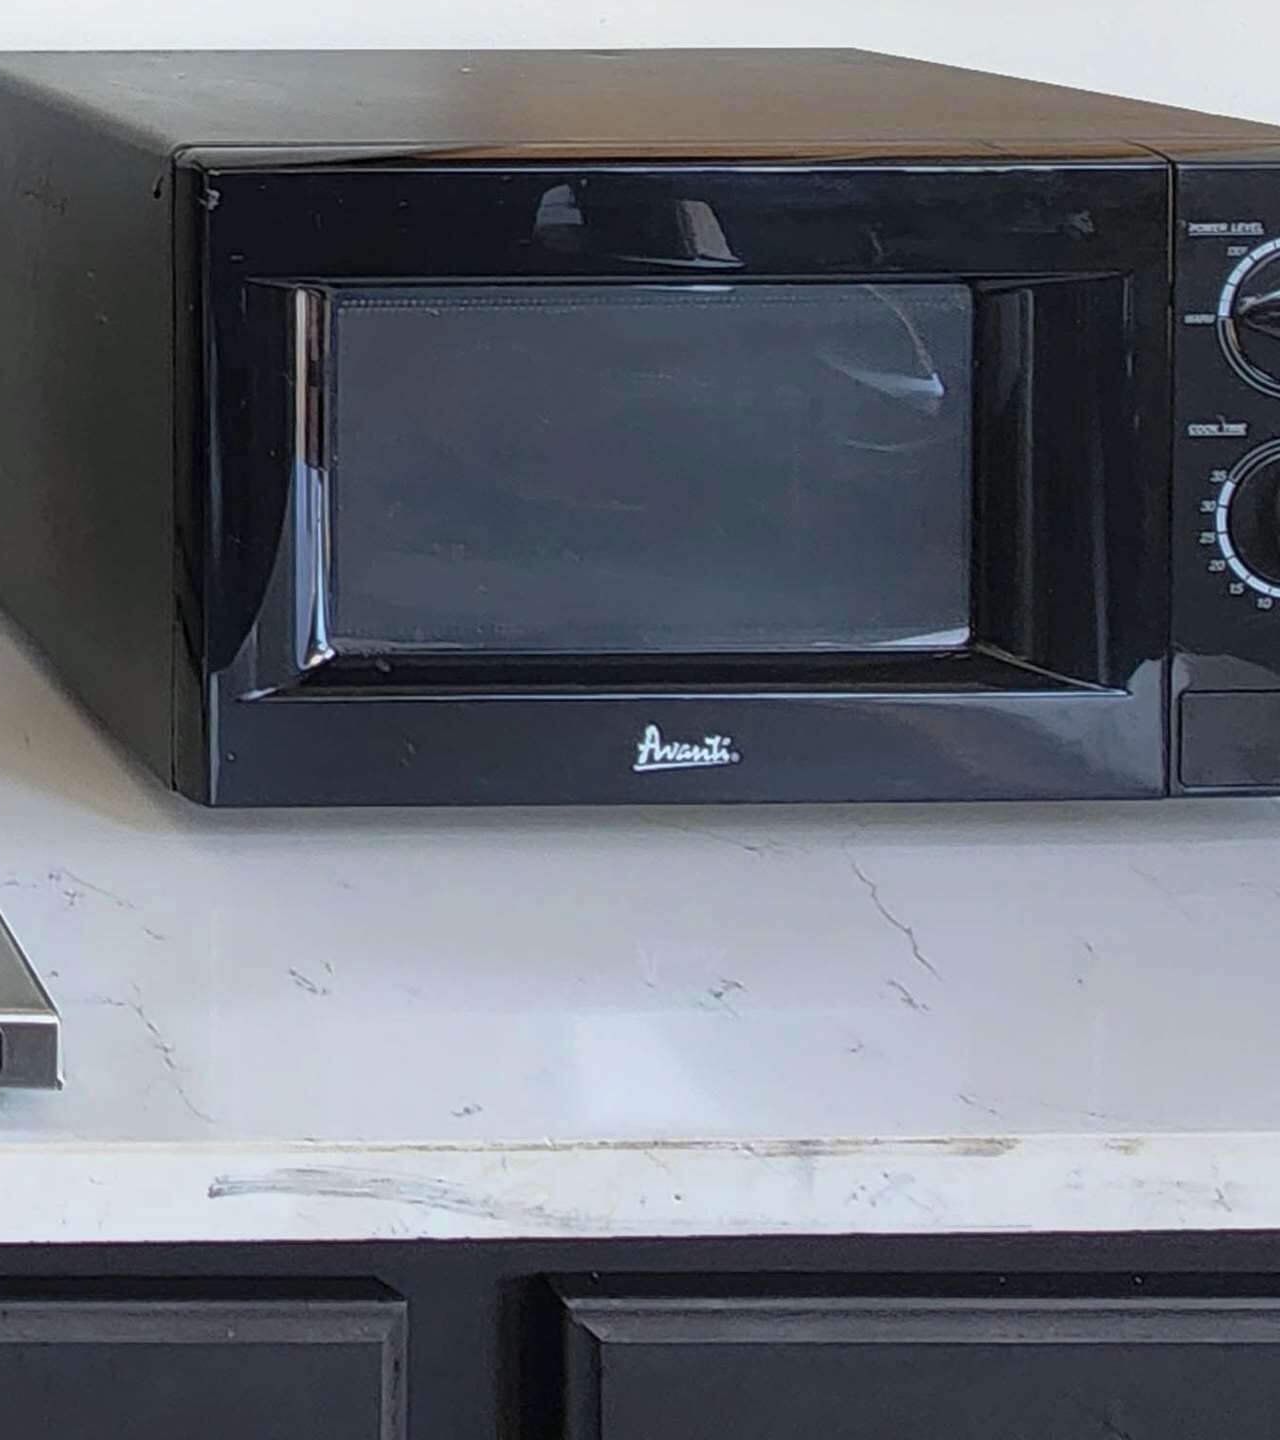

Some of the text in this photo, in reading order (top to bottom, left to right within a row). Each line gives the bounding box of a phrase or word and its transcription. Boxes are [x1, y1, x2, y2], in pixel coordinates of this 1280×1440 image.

[1210, 470, 1228, 483] 35
[1200, 500, 1217, 513] 30
[1208, 560, 1226, 572] 20
[1229, 583, 1244, 595] 15
[1256, 598, 1272, 609] 10
[637, 723, 733, 765] Avanti
